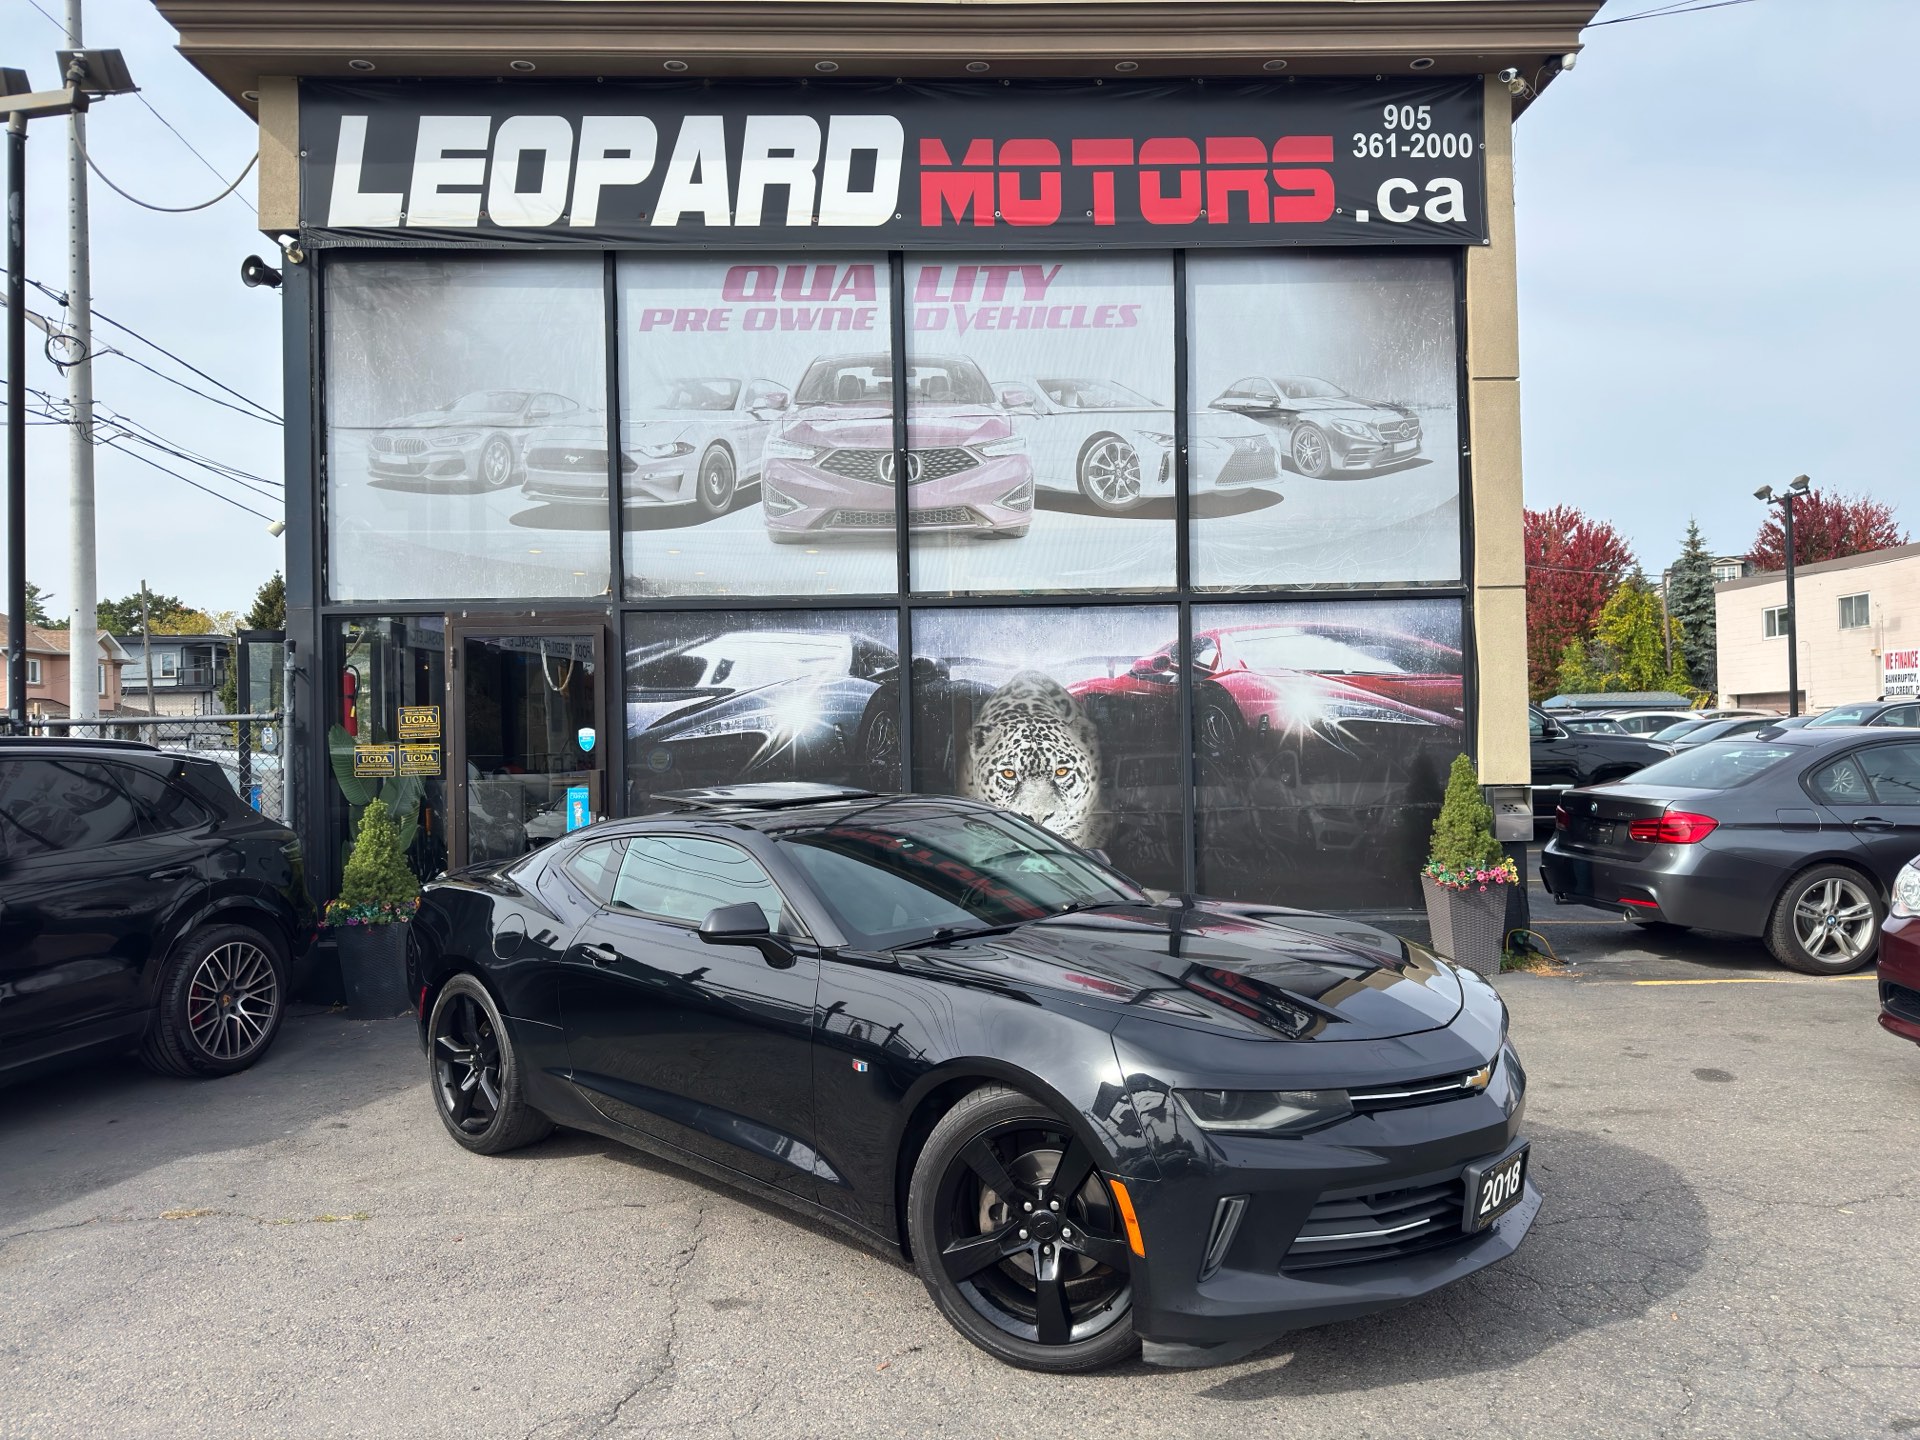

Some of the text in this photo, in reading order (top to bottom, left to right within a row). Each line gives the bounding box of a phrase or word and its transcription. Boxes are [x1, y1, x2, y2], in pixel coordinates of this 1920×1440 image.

[1383, 104, 1432, 131] 905
[1352, 133, 1473, 158] 361-2000
[327, 115, 1335, 227] LEOPARD MOTORS
[1355, 177, 1467, 223] .ca
[639, 308, 733, 332] PRE
[1885, 650, 1918, 670] WE FINANCE
[405, 715, 434, 724] UCDA
[406, 754, 434, 762] UCDA
[1480, 1160, 1521, 1215] 2018
